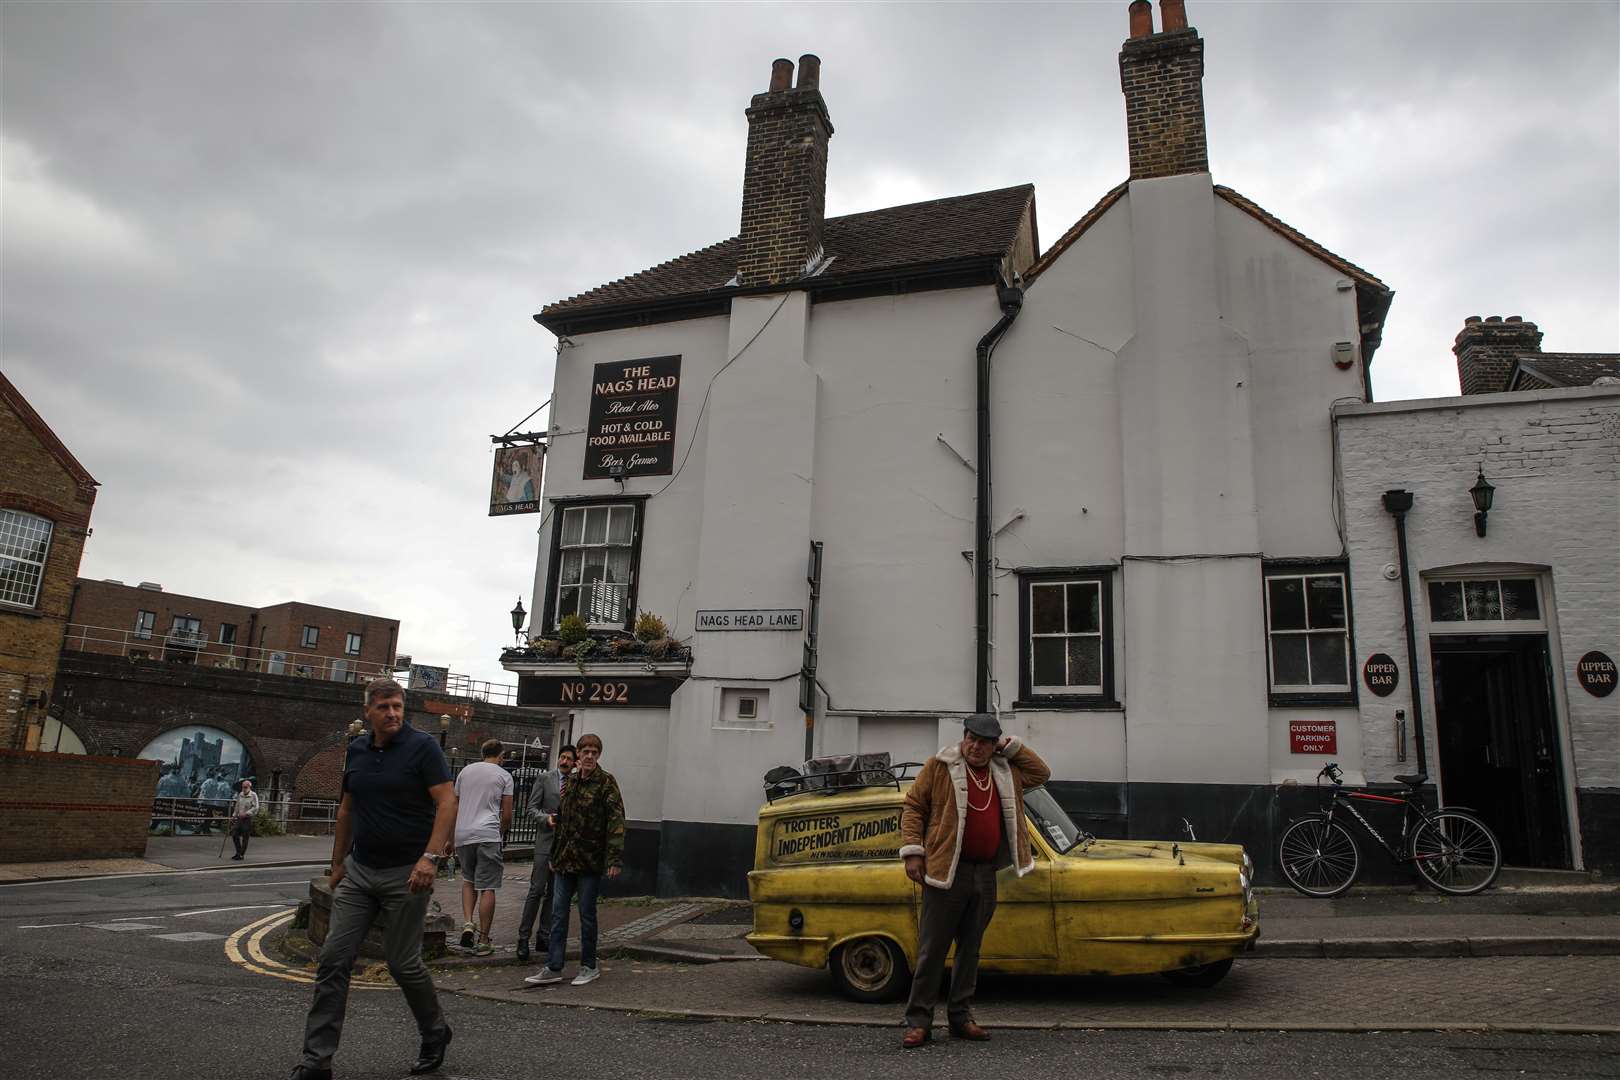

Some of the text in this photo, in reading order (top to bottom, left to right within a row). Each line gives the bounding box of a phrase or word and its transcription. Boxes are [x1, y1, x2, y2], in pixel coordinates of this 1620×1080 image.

[623, 366, 650, 378] THE
[595, 376, 676, 395] NAGS HEAD
[605, 400, 659, 414] Real Ales
[601, 421, 663, 434] HOT & COLD
[589, 431, 671, 446] FOOD AVAILABLE
[598, 453, 658, 469] Bar Games
[515, 502, 534, 511] HEAD
[700, 614, 798, 626] NAGS HEAD LANE
[1367, 663, 1396, 673] UPPER
[1580, 661, 1614, 672] UPPER
[1371, 675, 1393, 685] BAR
[1587, 673, 1612, 683] BAR
[589, 682, 628, 701] 292
[1290, 724, 1335, 732] CUSTOMER
[1295, 734, 1330, 742] PARKING
[1302, 744, 1324, 752] ONLY
[784, 817, 840, 833] TROTTERS
[777, 815, 898, 856] INDEPENDENT TRADING
